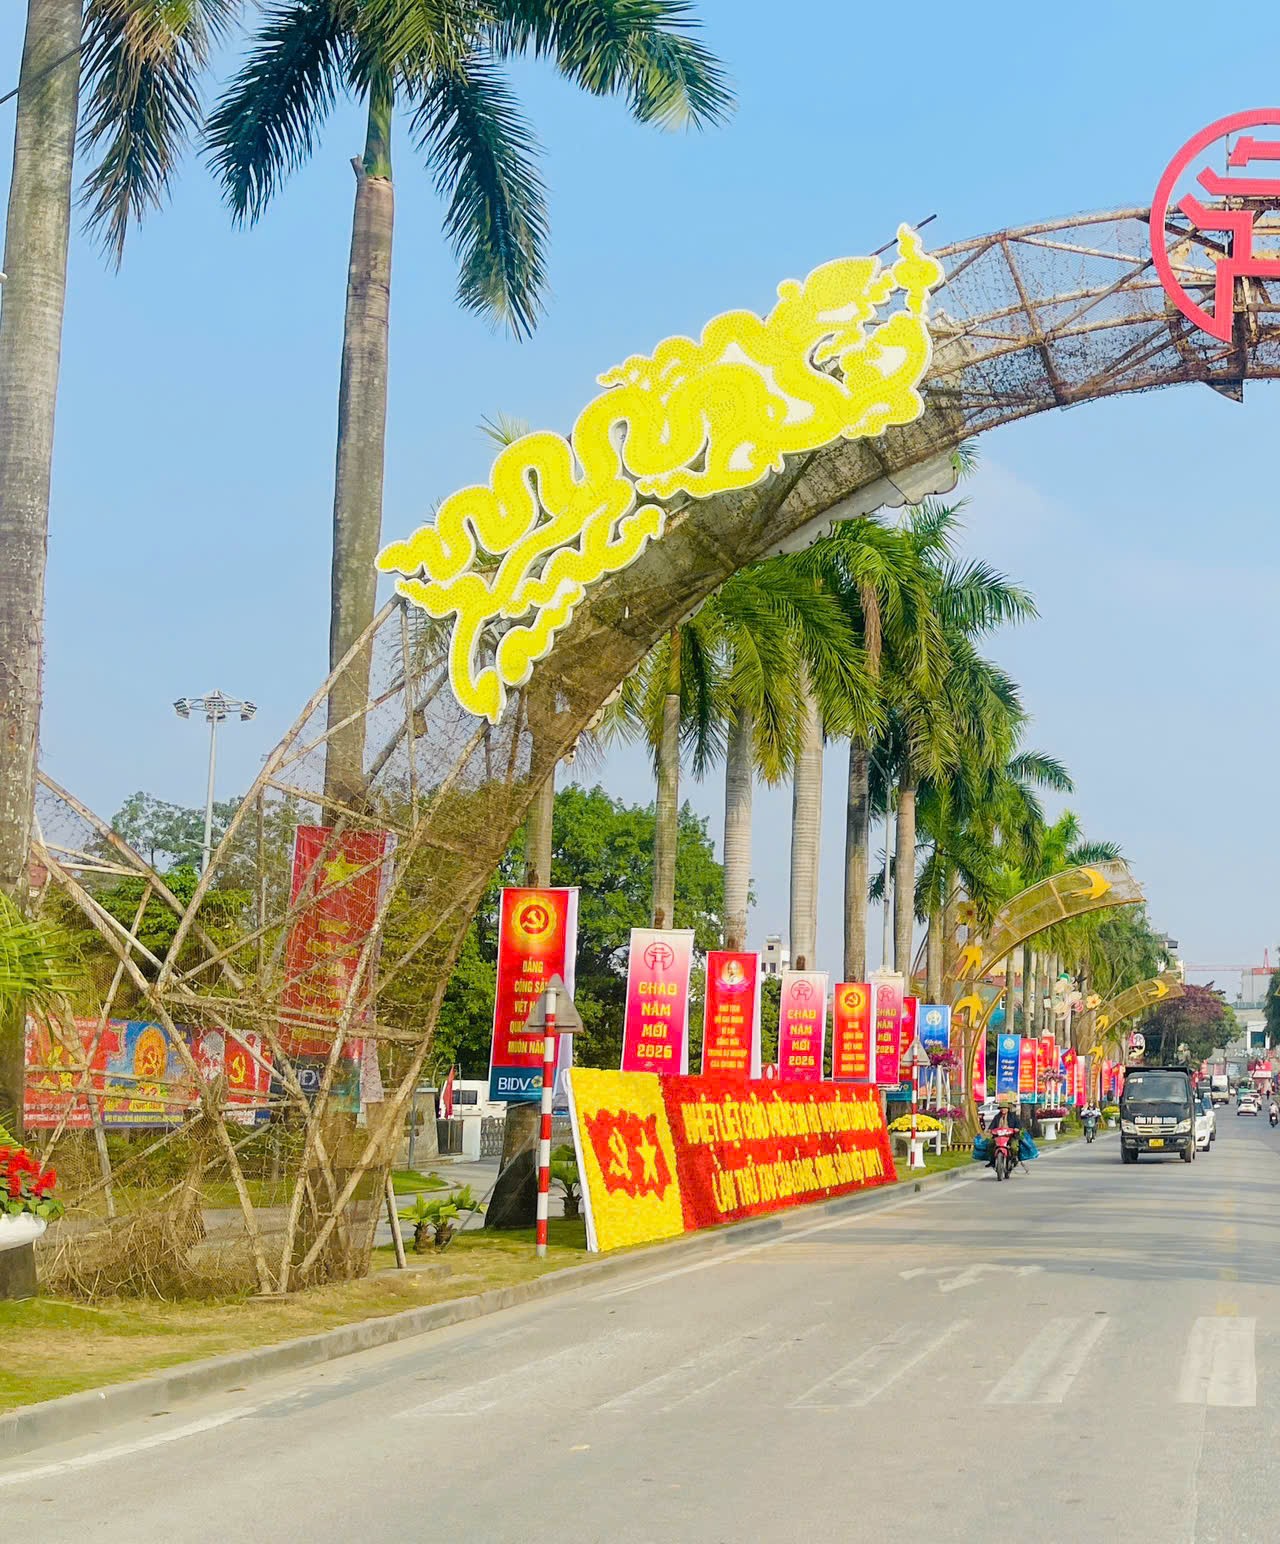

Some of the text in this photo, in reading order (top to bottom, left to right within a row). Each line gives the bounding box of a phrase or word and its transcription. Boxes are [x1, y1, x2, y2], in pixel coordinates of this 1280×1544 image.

[535, 977, 548, 993] SẢ
[636, 1043, 673, 1059] 2026
[497, 1077, 532, 1091] BIDV
